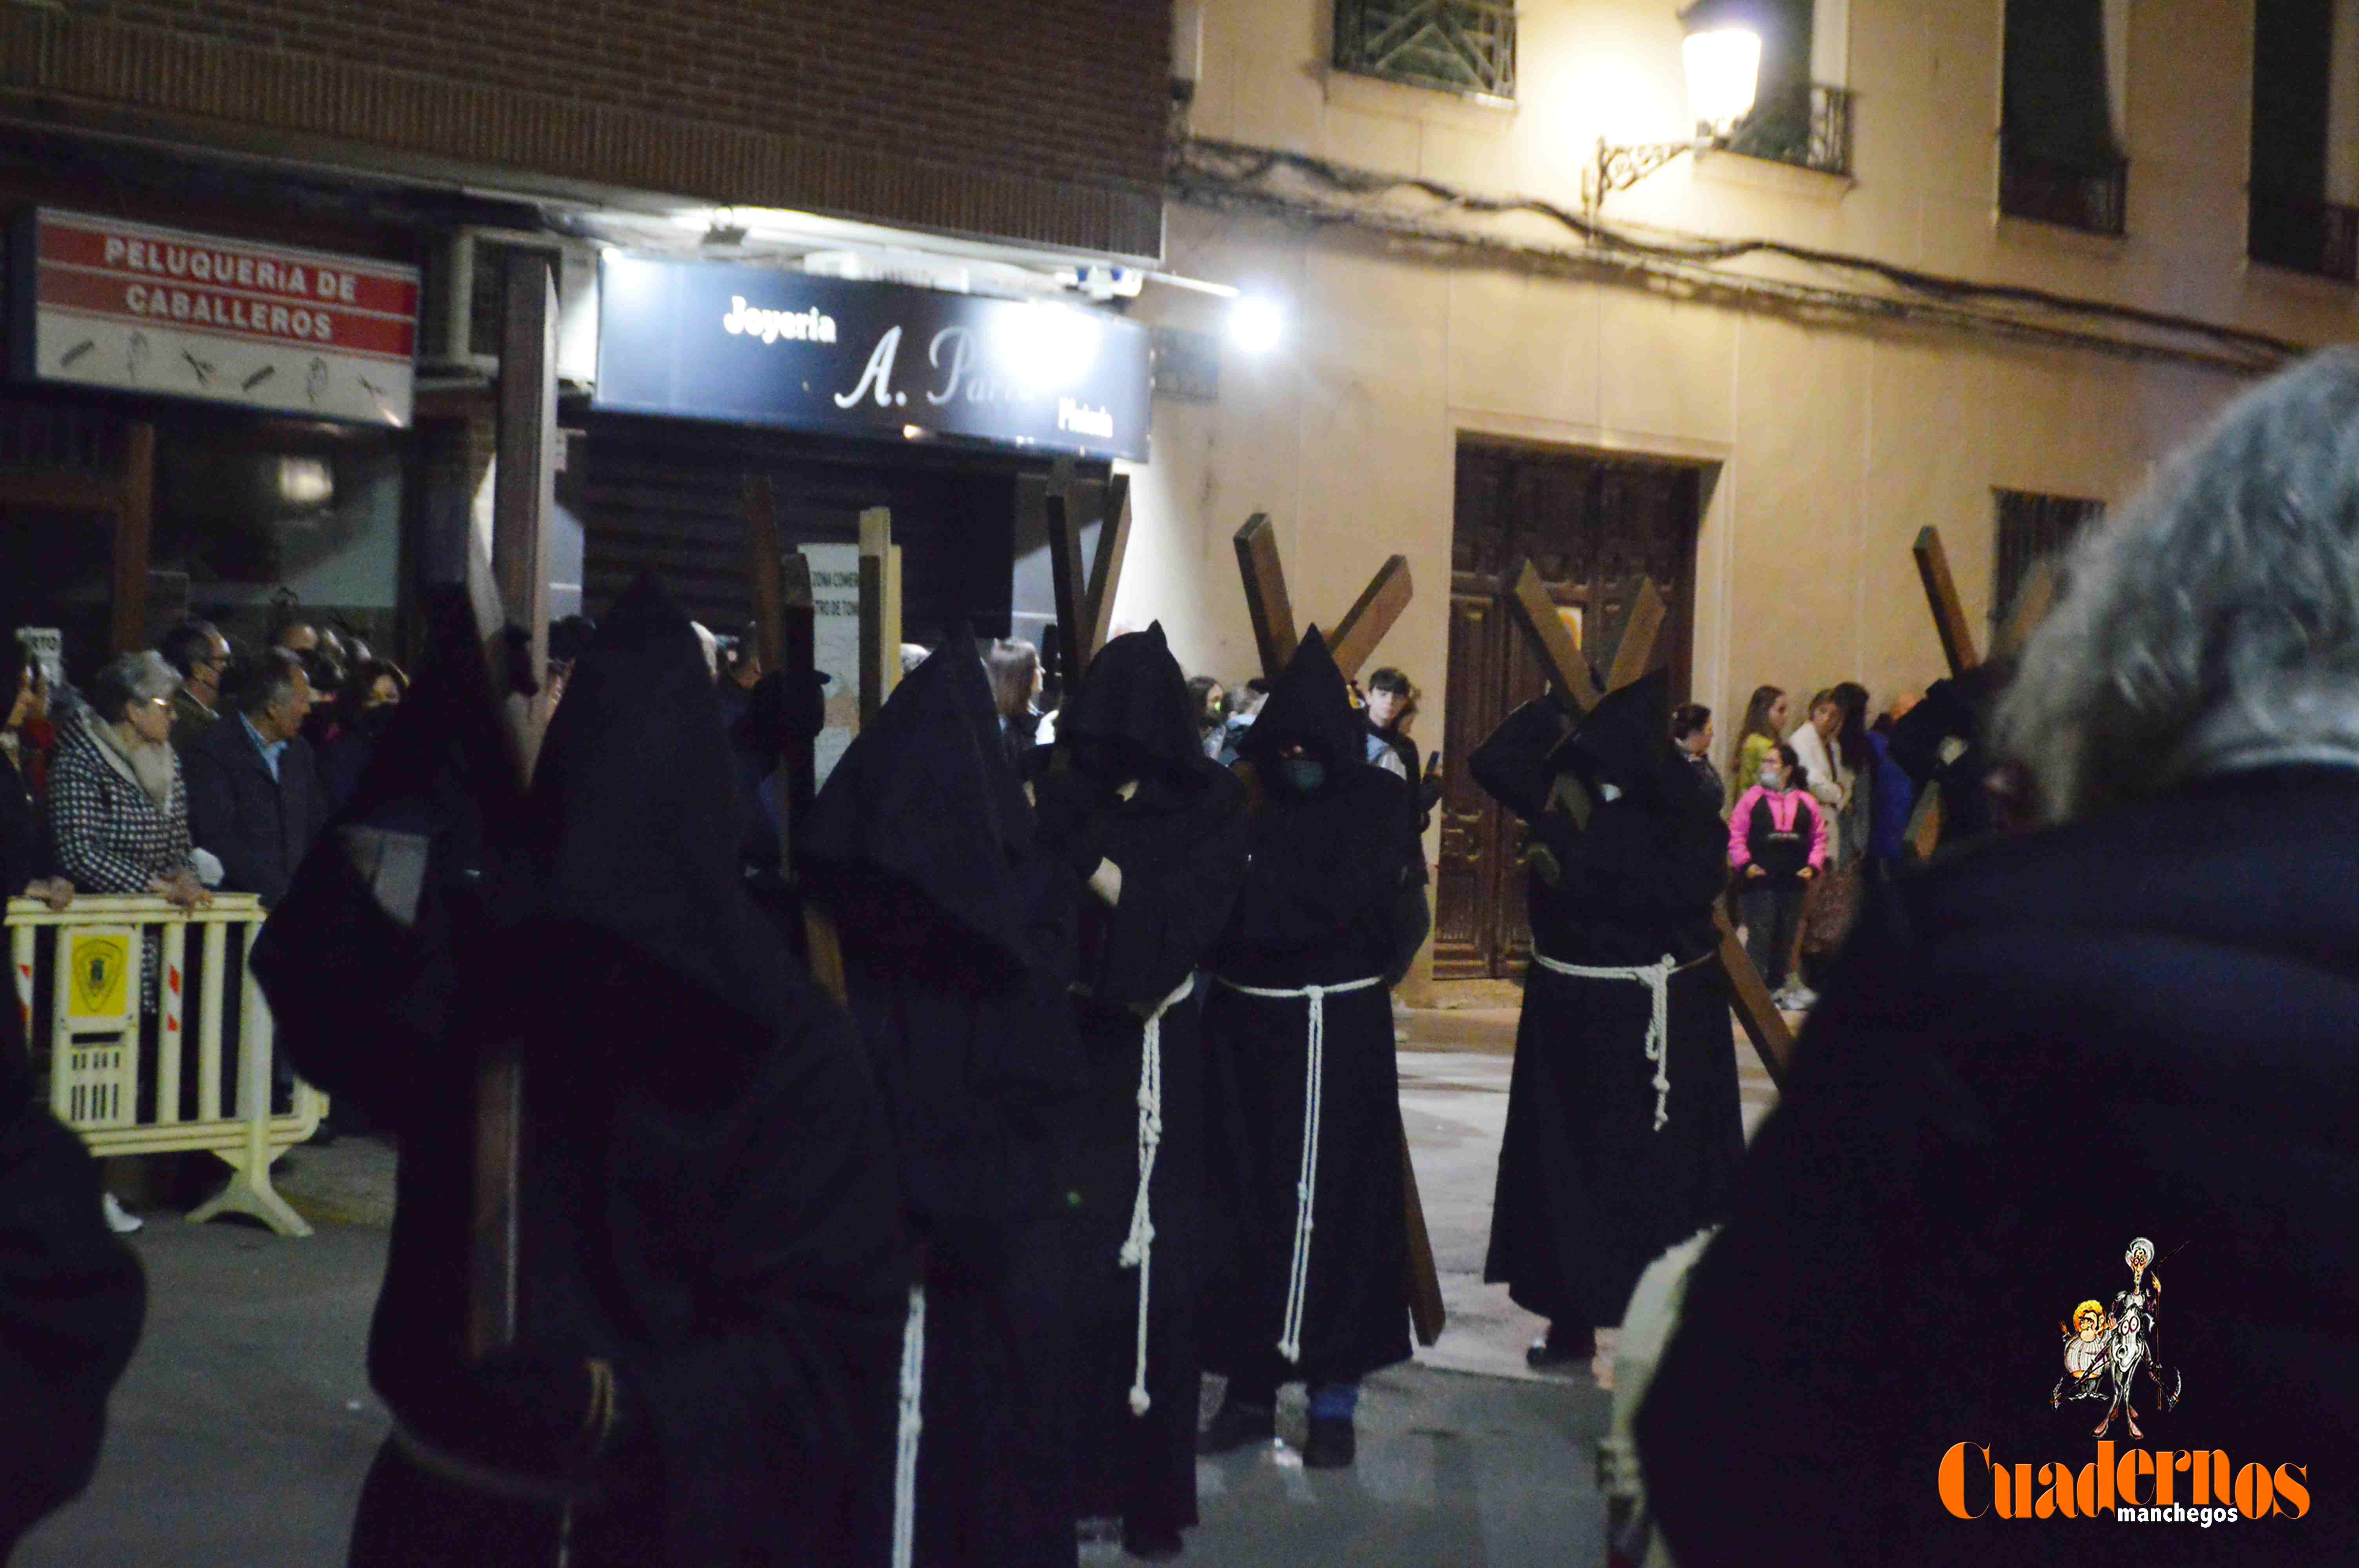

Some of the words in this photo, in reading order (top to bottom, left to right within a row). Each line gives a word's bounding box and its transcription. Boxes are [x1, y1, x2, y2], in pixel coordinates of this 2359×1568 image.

[125, 285, 333, 340] CABALLEROS
[317, 270, 356, 302] DE
[834, 326, 907, 408] A.
